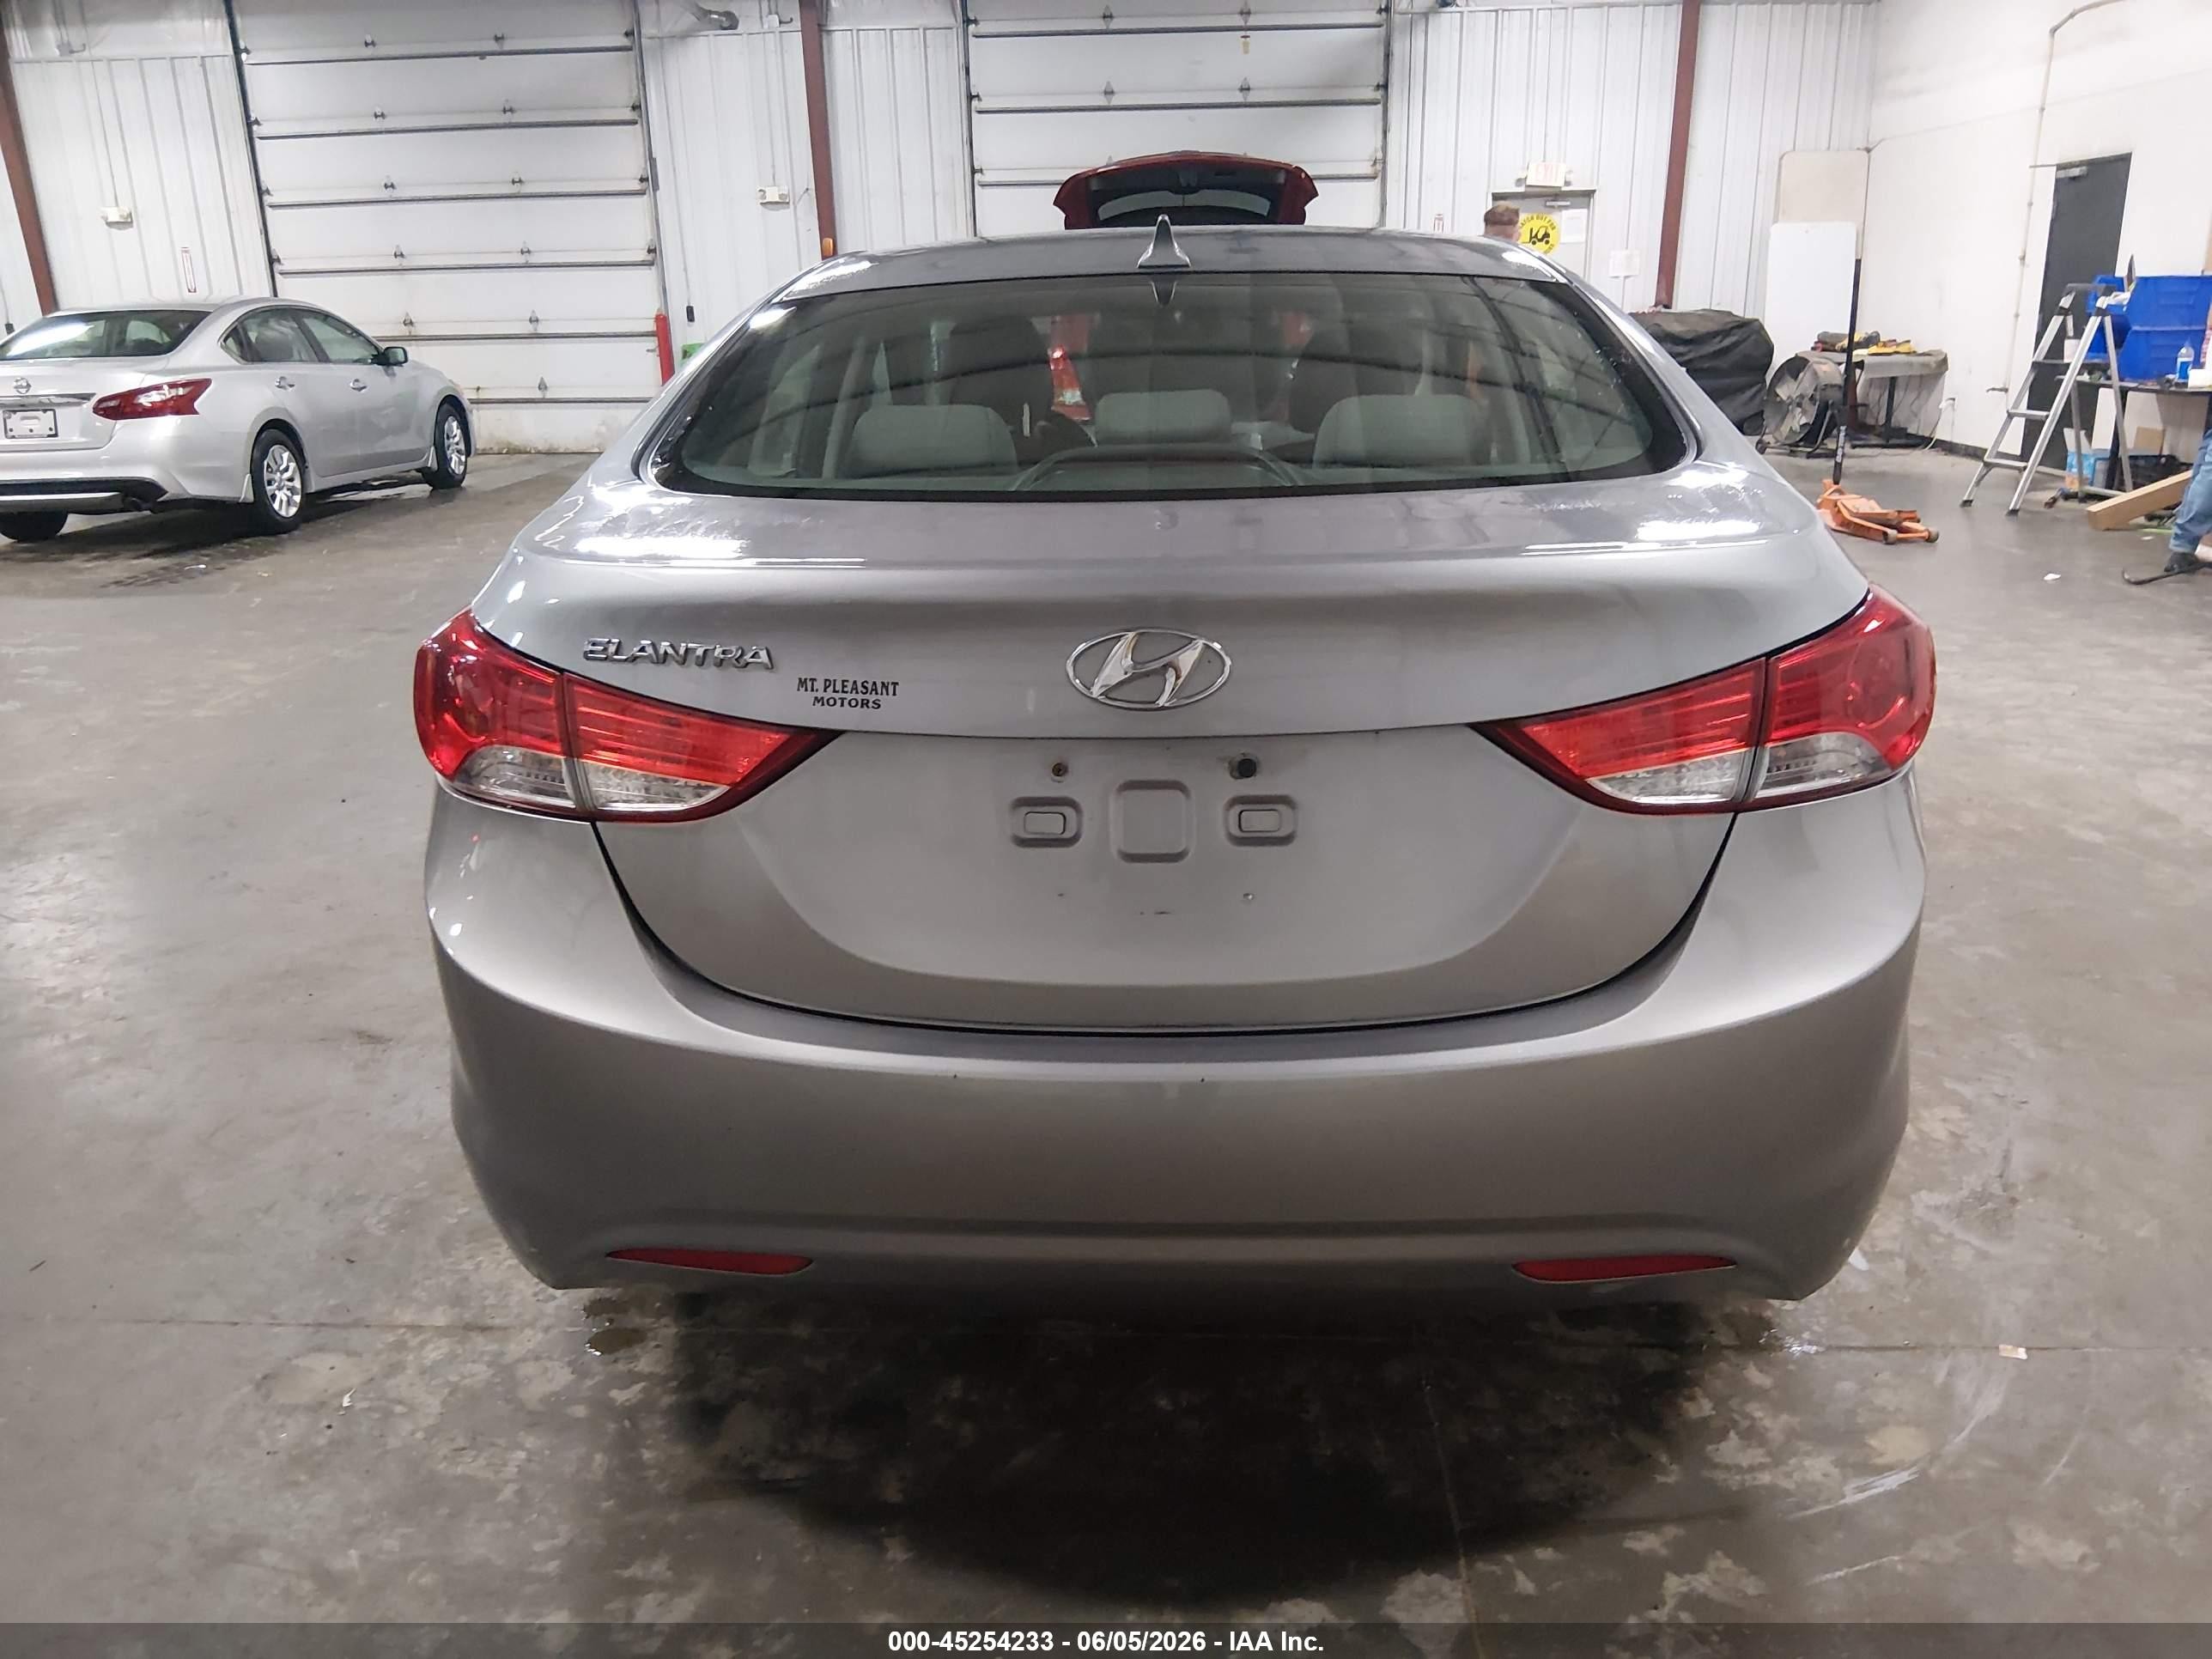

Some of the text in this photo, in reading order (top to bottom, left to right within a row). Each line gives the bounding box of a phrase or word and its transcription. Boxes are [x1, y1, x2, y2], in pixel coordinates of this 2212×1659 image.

[583, 637, 774, 670] ELANTRA
[797, 677, 899, 696] MT. PLEASANT
[812, 696, 882, 709] MOTORS
